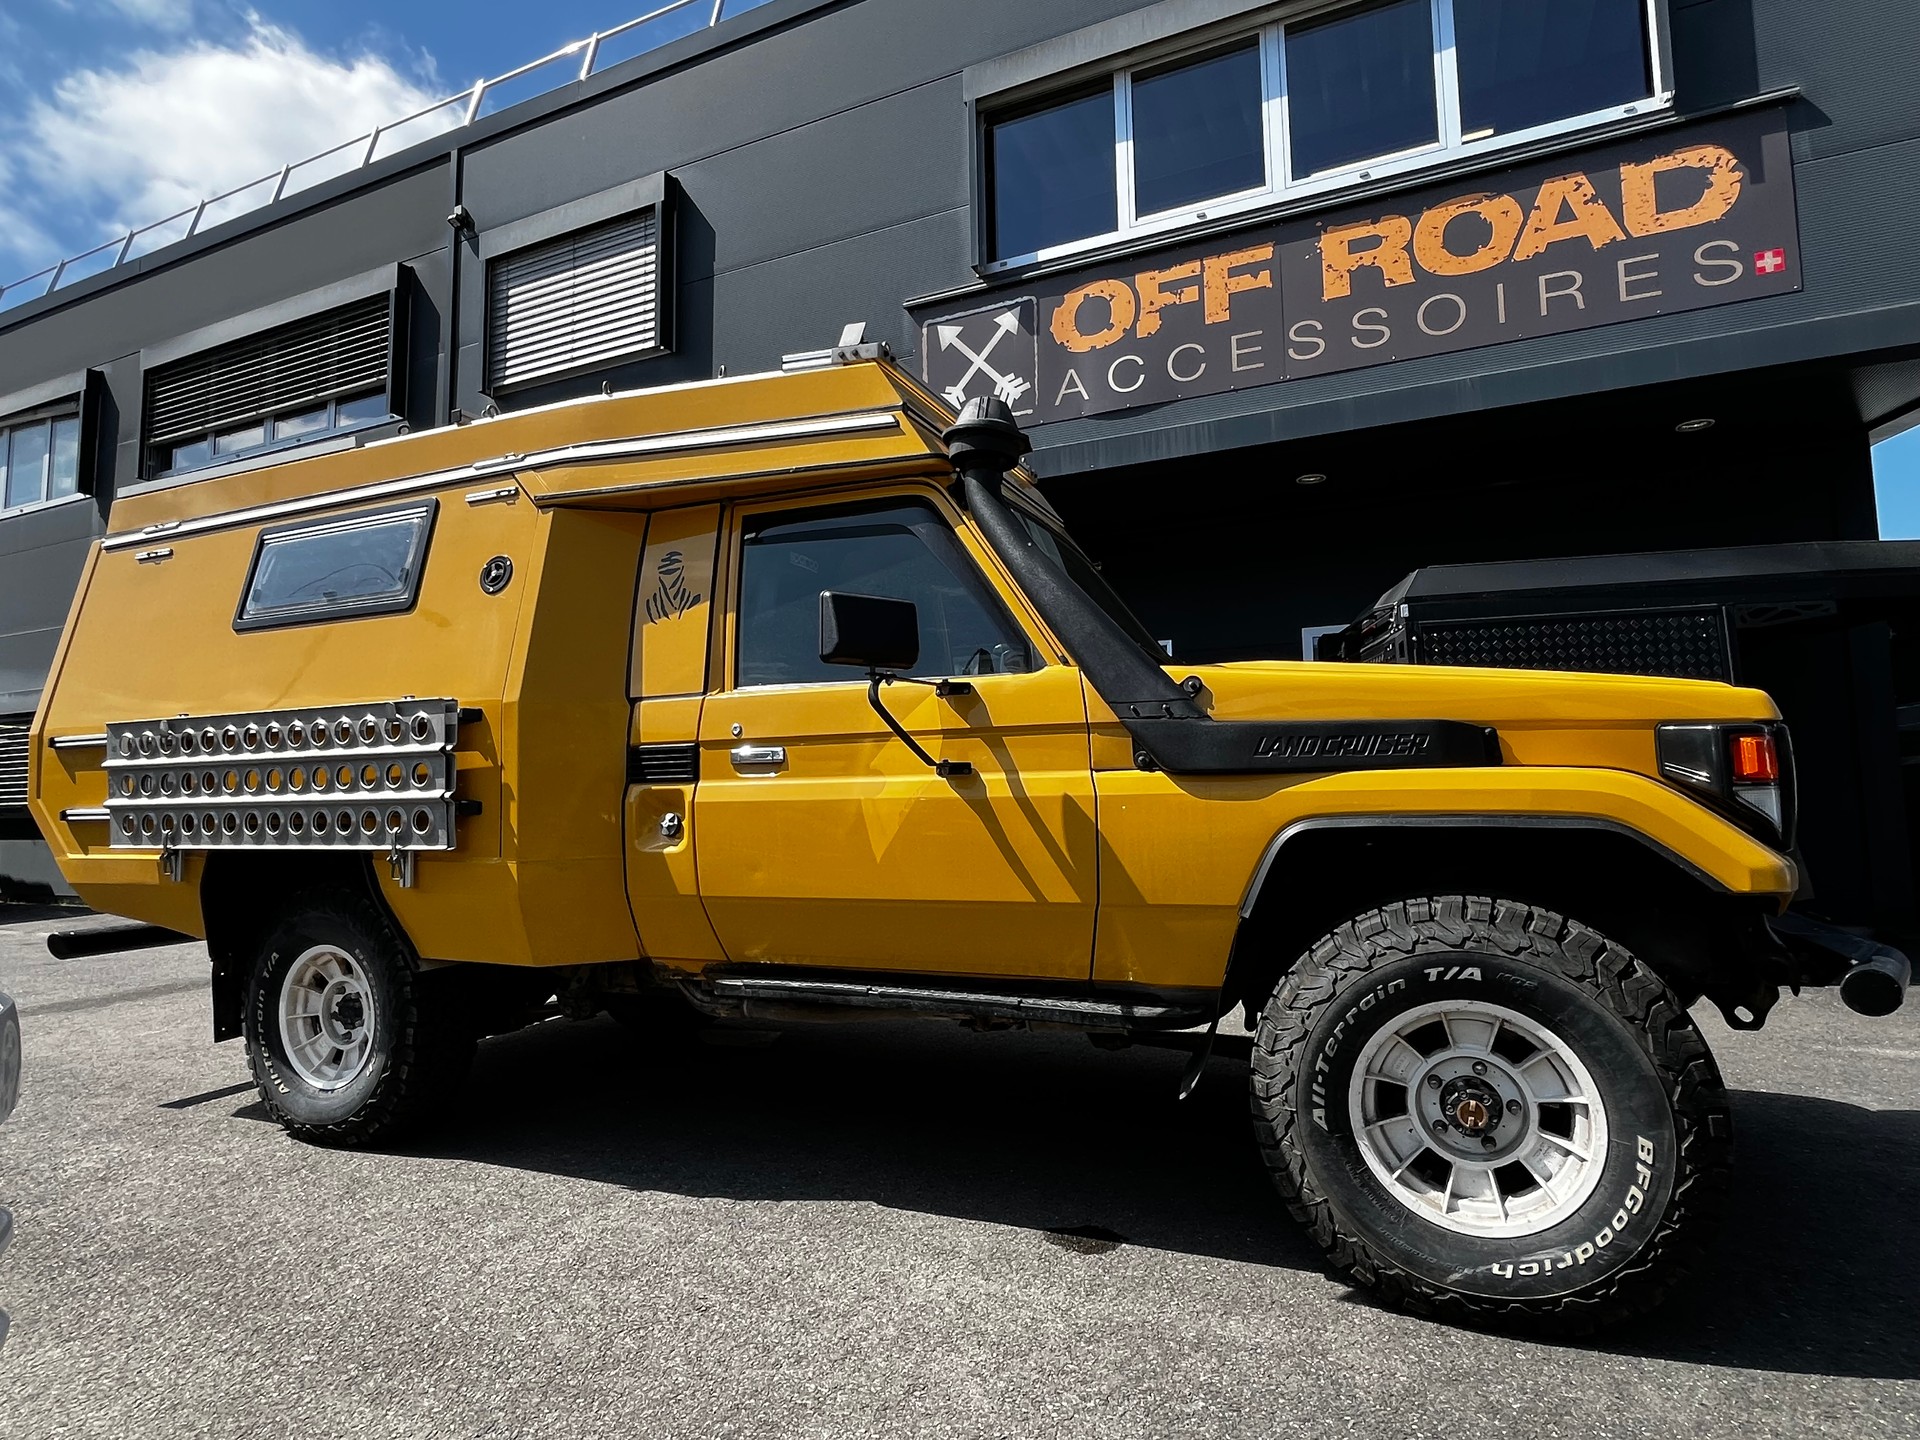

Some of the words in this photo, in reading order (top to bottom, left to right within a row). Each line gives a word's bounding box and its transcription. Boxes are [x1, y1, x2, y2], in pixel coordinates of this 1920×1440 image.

[1050, 243, 1274, 352] OFF
[1318, 144, 1743, 302] ROAD
[1054, 240, 1744, 406] ACCESSOIRES
[1253, 735, 1322, 758] LAND
[1322, 734, 1430, 757] CRUISER
[1312, 978, 1406, 1131] All-Terrain
[1423, 965, 1483, 983] T/A
[1491, 1135, 1656, 1280] BFGoodrich
